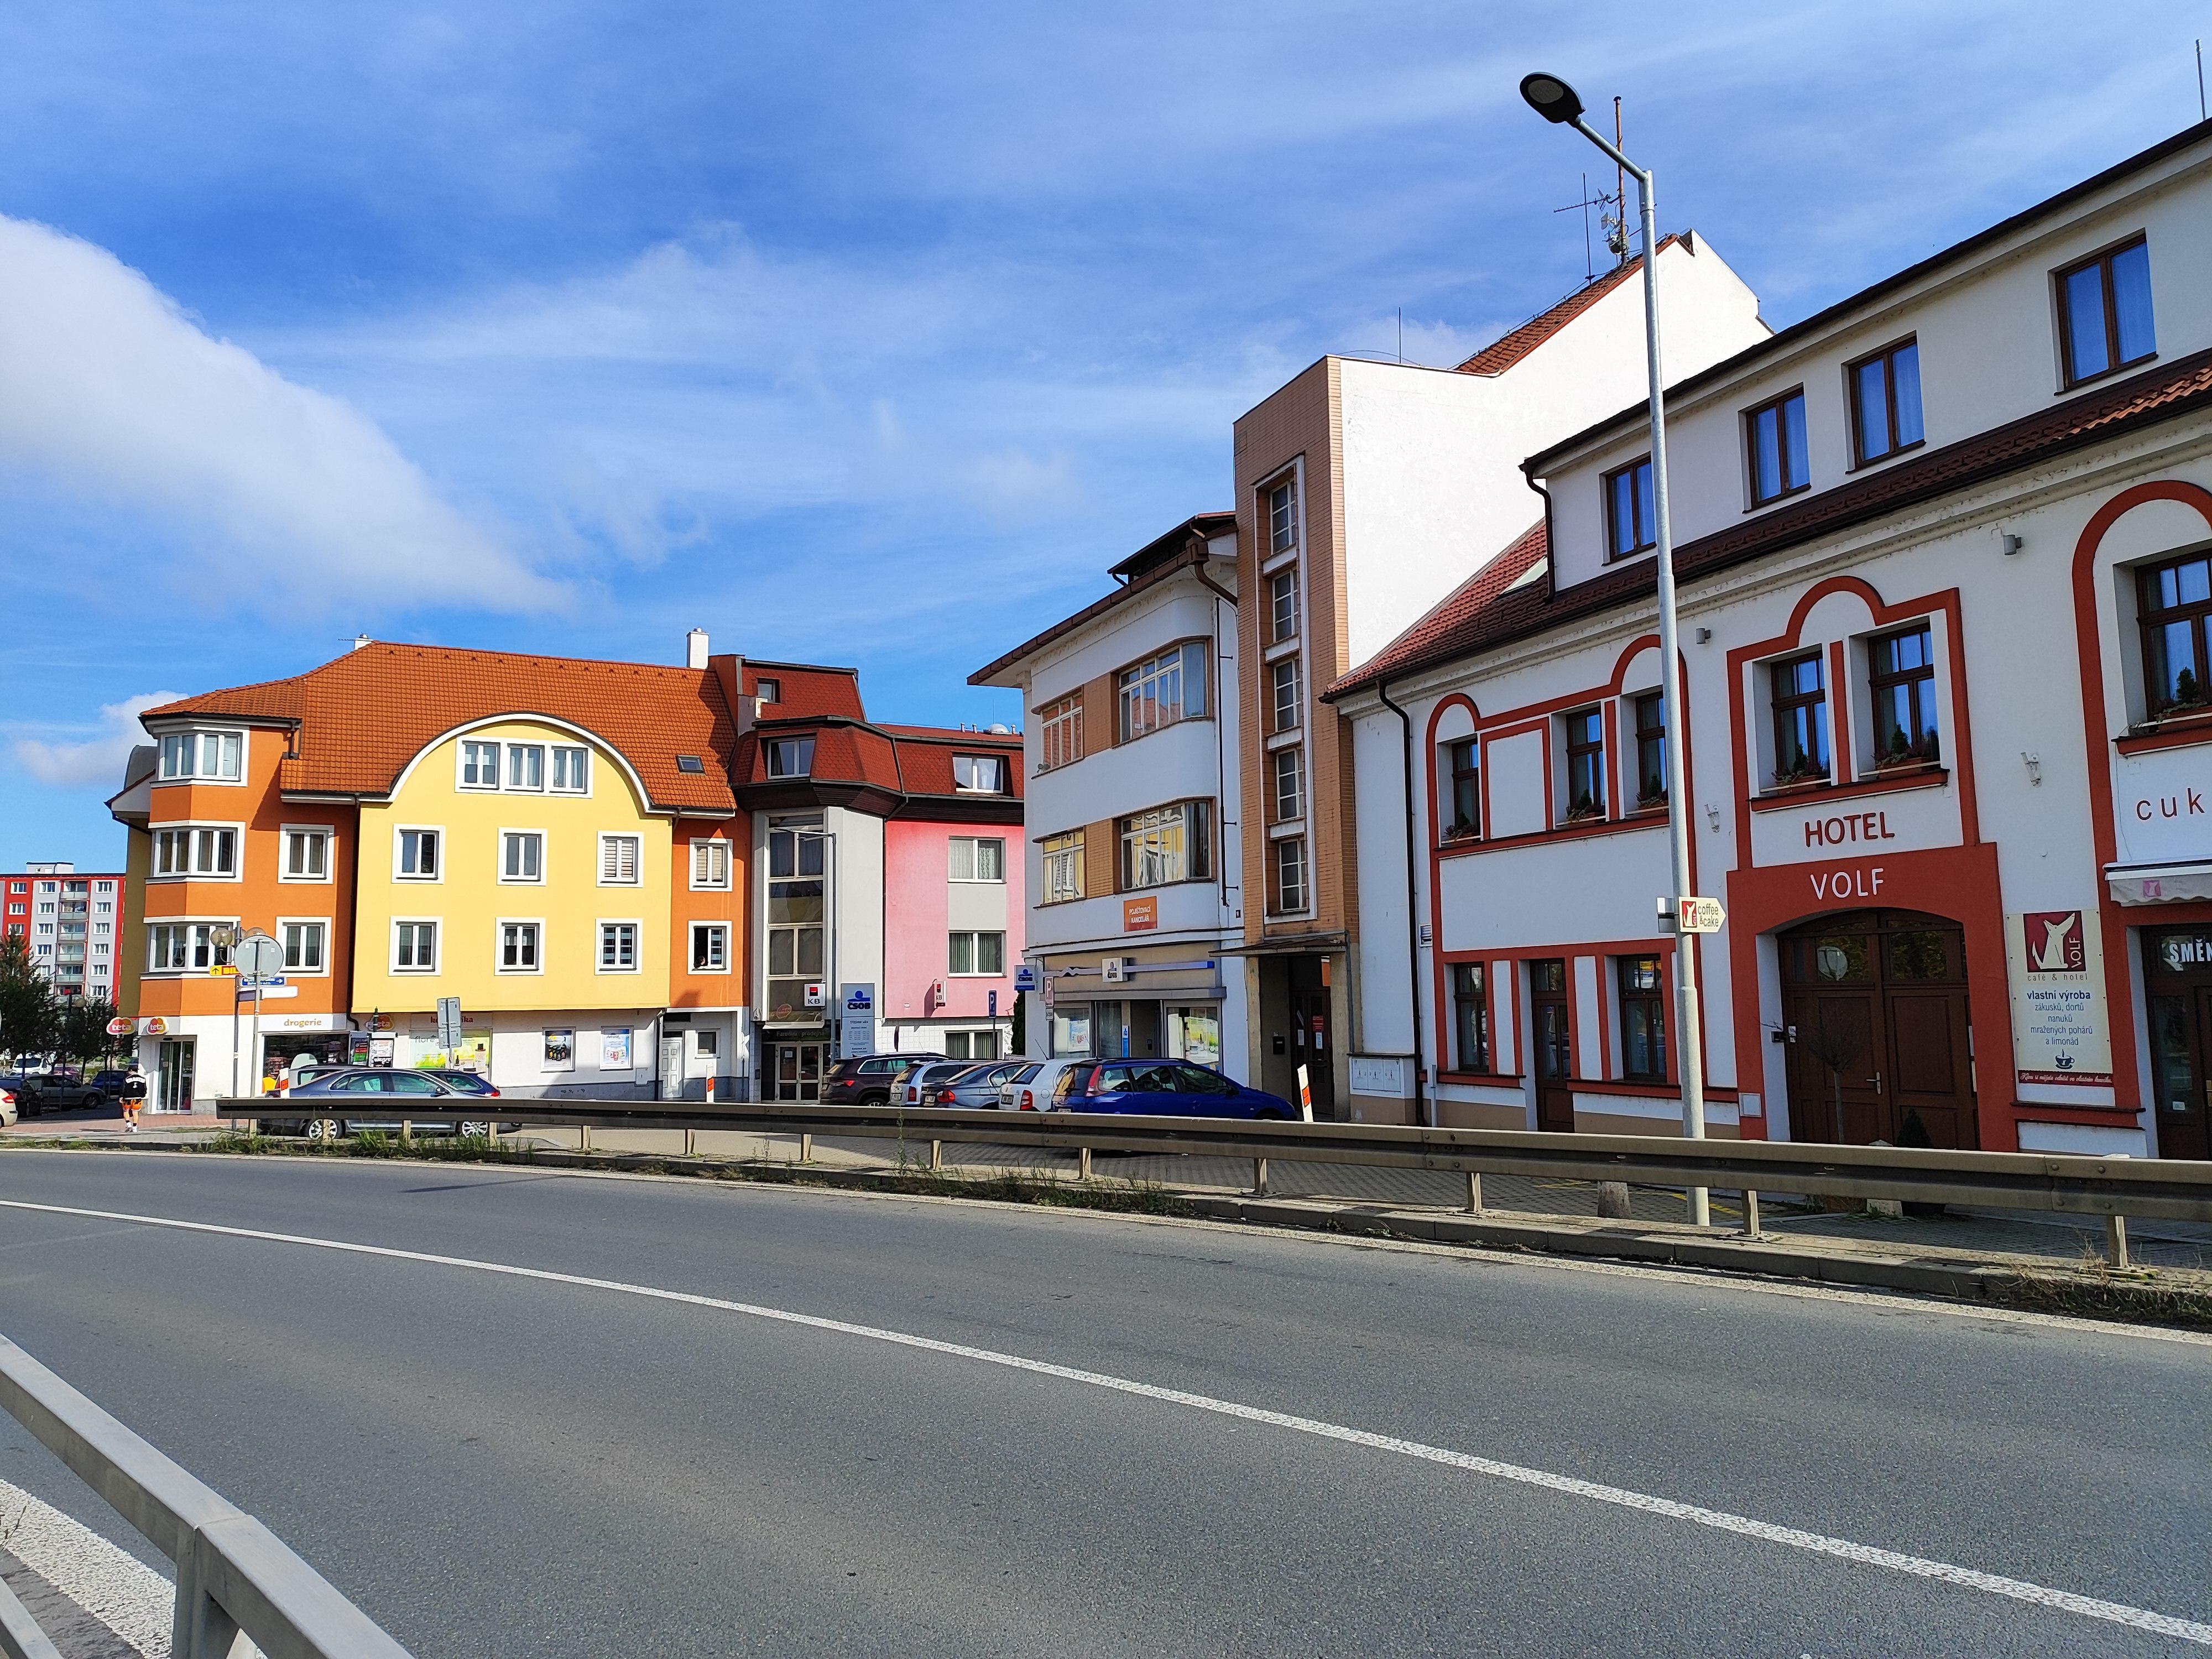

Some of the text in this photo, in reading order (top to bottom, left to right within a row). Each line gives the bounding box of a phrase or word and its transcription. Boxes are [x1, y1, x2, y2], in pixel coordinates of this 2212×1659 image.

[1804, 811, 1895, 848] HOTEL
[1810, 868, 1884, 900] VOLF
[1698, 902, 1719, 915] coffee
[1130, 914, 1150, 924] KANCELÁŘ
[2069, 937, 2082, 968] VOLF
[2063, 973, 2088, 981] hotel
[1046, 980, 1052, 998] P
[2026, 990, 2091, 1001] vlastní výroba
[847, 1001, 871, 1010] ČSOB
[990, 994, 995, 1010] P
[2034, 1002, 2084, 1011] zákusků, dortů
[284, 1018, 322, 1027] drogerie
[2047, 1014, 2073, 1022] nanuků
[2030, 1025, 2093, 1036] mražených pohárů
[2052, 1037, 2079, 1045] limonád
